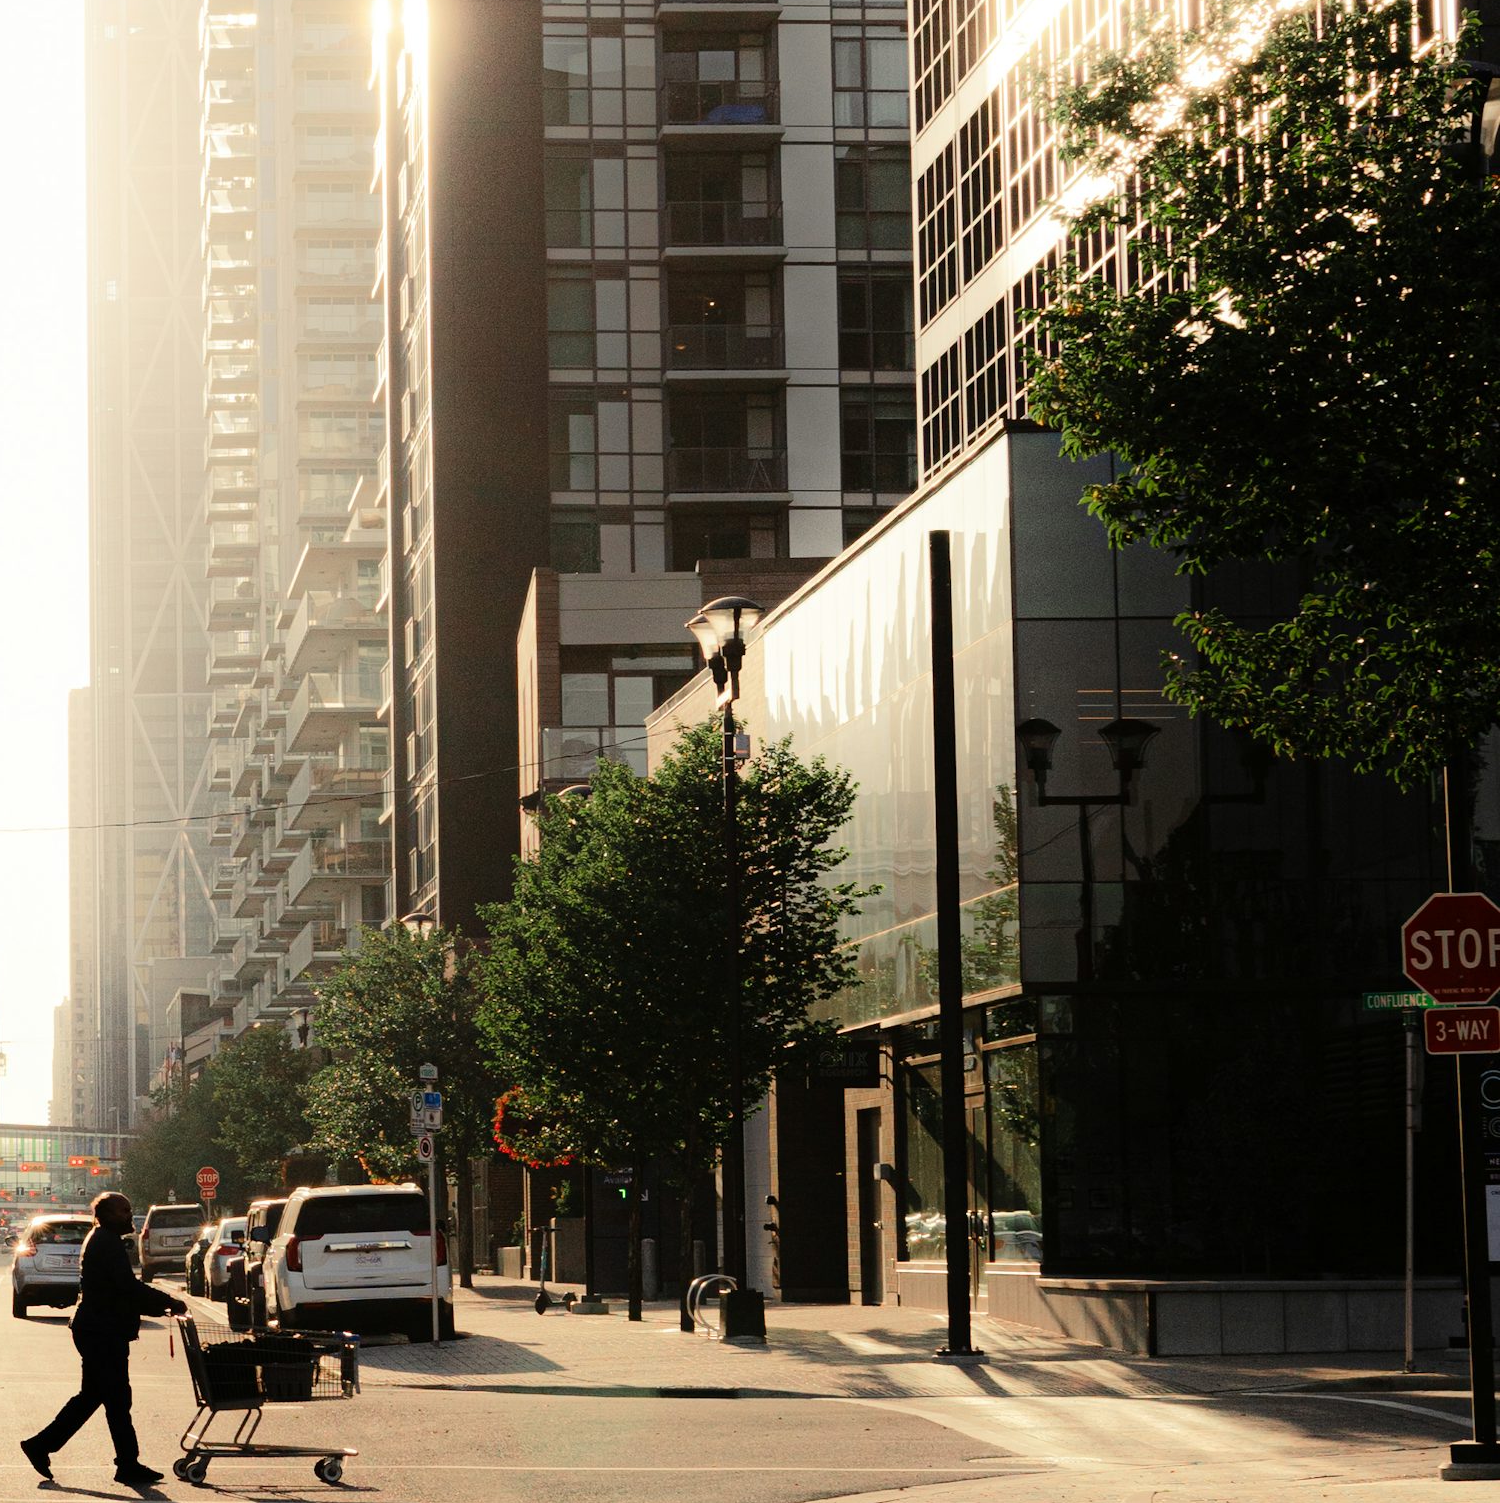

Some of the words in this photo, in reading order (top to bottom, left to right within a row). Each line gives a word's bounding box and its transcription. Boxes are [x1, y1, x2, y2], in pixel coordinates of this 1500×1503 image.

[1367, 993, 1428, 1009] CONFLUENCE
[1435, 1019, 1491, 1042] 3-WAY
[198, 1173, 218, 1183] STOP
